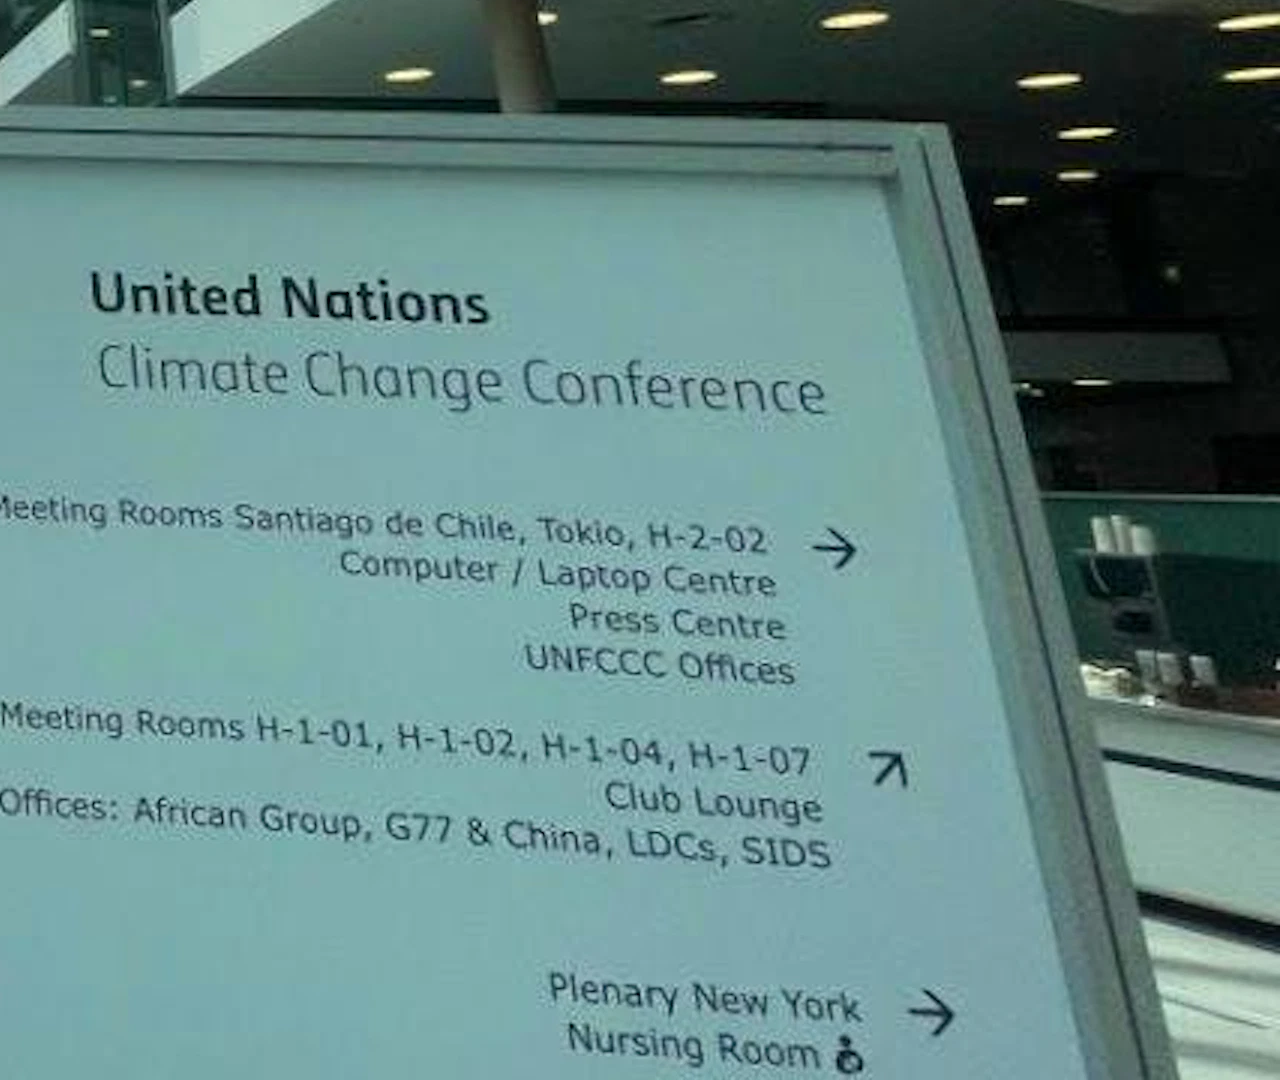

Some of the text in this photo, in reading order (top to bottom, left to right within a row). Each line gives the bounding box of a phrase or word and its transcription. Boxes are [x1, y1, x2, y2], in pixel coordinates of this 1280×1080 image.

[88, 268, 493, 327] United Nations
[97, 341, 828, 417] Climate Change Conference
[116, 496, 226, 530] Rooms
[232, 502, 375, 542] Santiago
[384, 509, 425, 539] de
[432, 509, 528, 548] Chile,
[534, 515, 637, 555] Tokio,
[645, 521, 770, 556] H-2-02
[338, 547, 778, 599] Computer / Laptop Centre
[567, 600, 789, 642] Press Centre
[522, 642, 797, 687] UNFCCC Offices
[134, 707, 247, 743] Rooms
[255, 711, 386, 757] H-1-01,
[396, 721, 530, 766] H-1-02,
[539, 730, 677, 775] H-1-04,
[686, 740, 812, 778] H-1-07
[603, 778, 825, 830] Club Lounge
[132, 794, 249, 832] African
[258, 801, 374, 845] Group,
[384, 810, 455, 845] G77
[465, 815, 492, 847] &
[500, 817, 615, 863] China,
[624, 826, 730, 871] LDCs,
[740, 834, 834, 871] SIDS
[546, 969, 865, 1024] Plenary New York
[565, 1020, 823, 1071] Nursing Room
